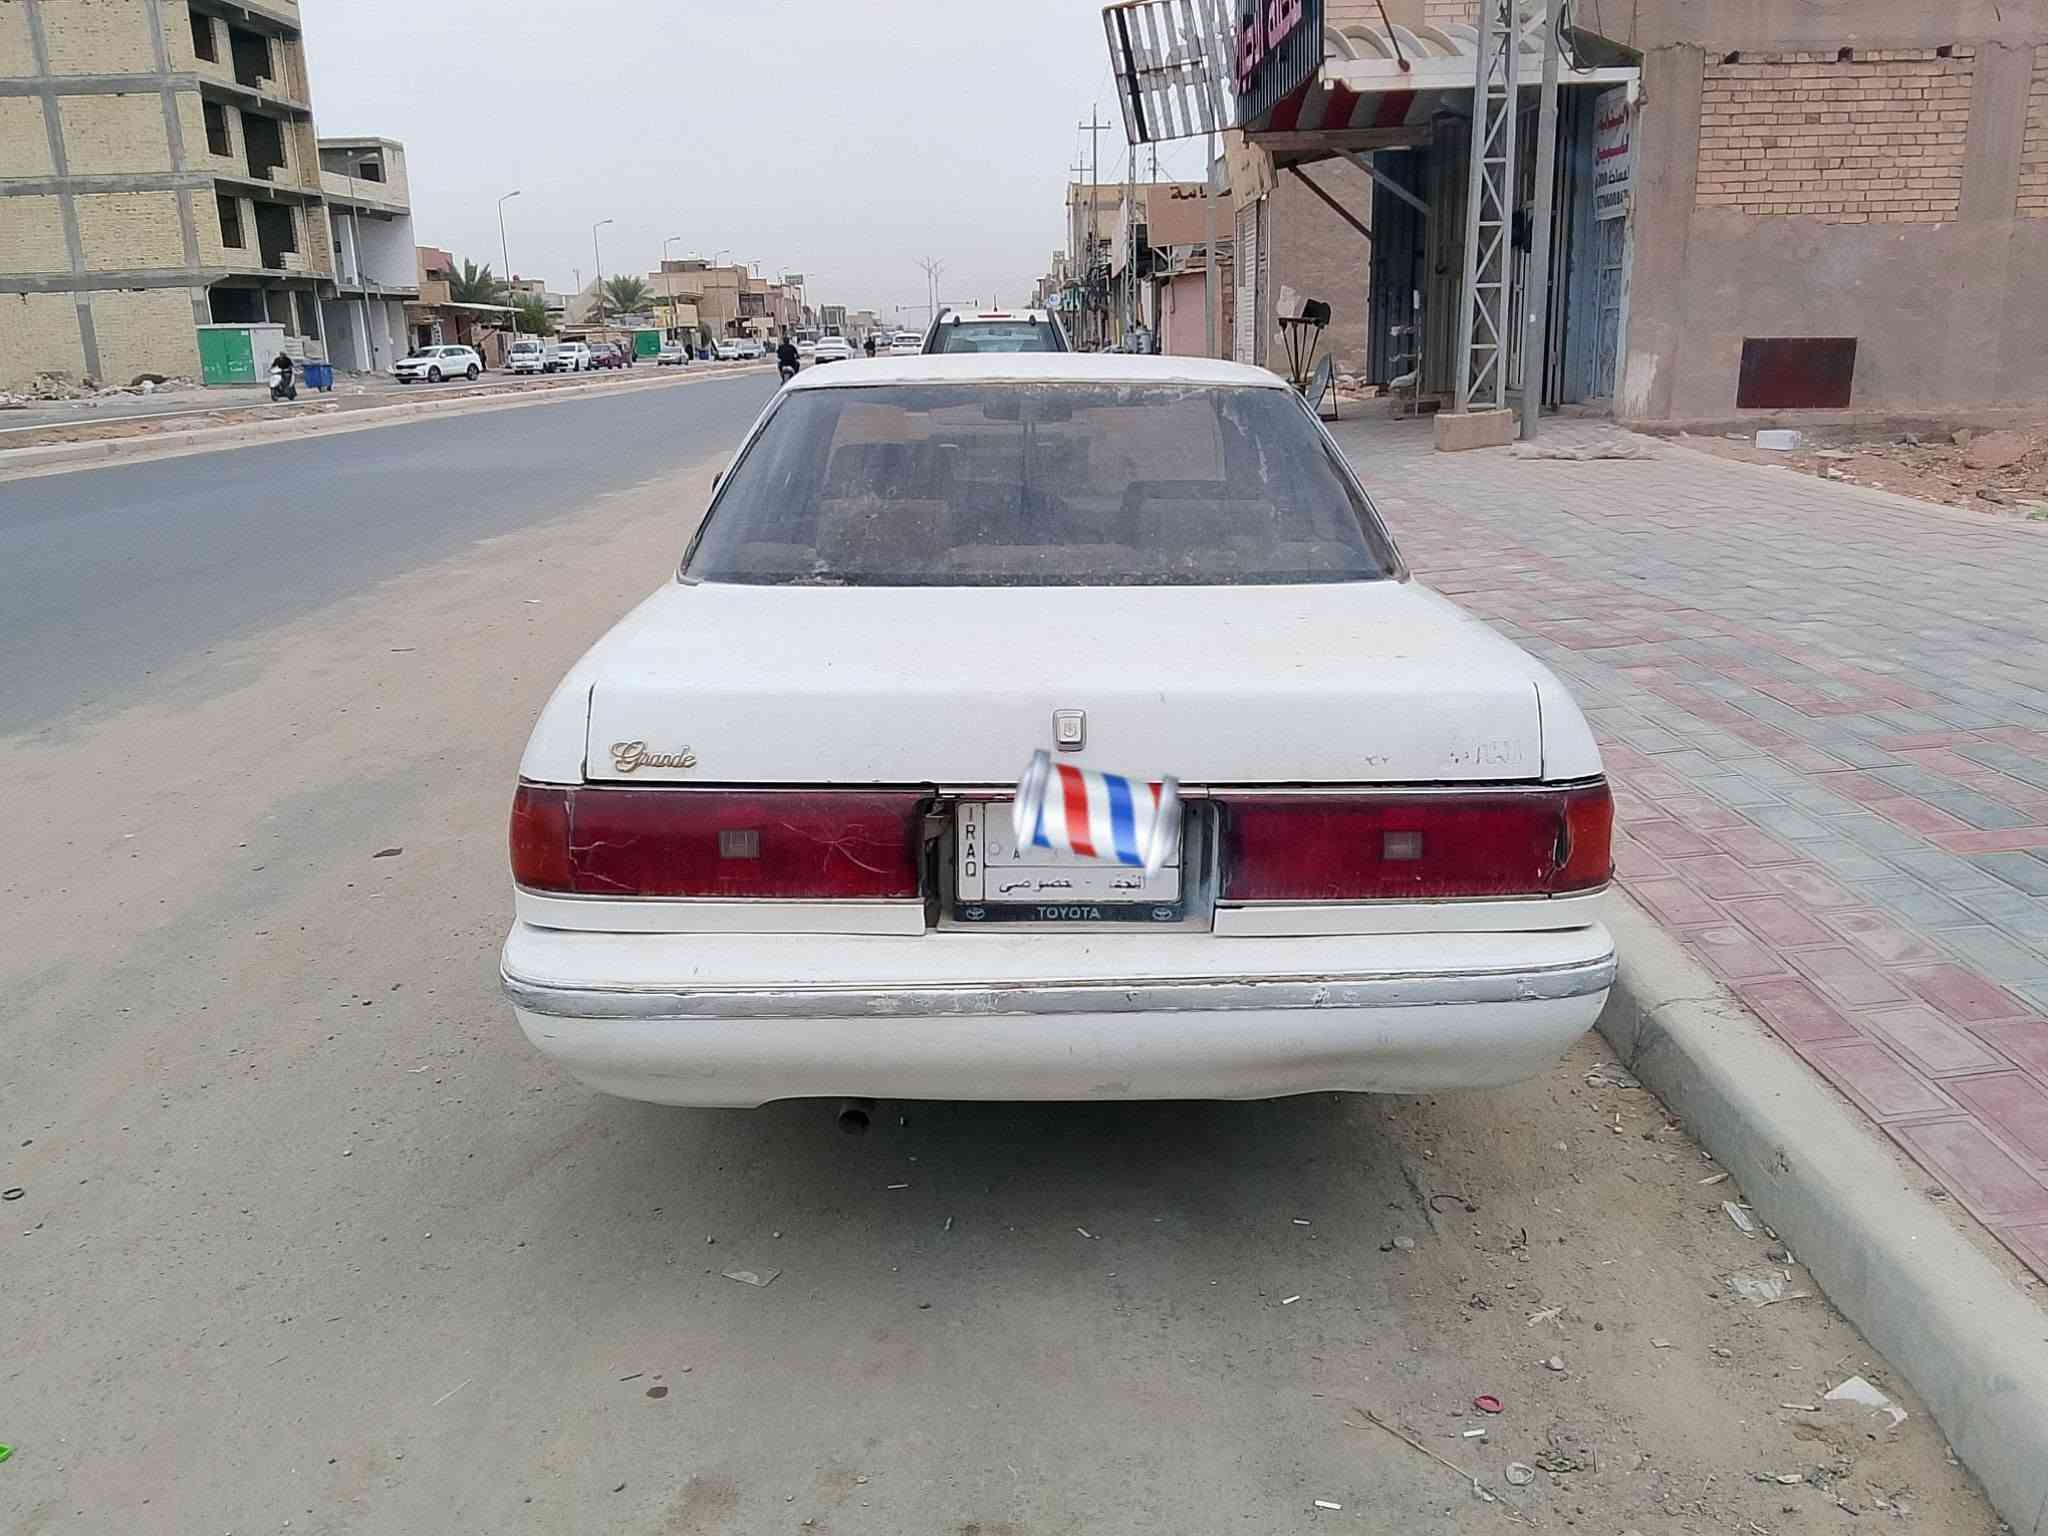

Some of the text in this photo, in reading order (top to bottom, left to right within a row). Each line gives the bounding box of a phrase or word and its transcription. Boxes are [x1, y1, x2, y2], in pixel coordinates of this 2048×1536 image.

[610, 739, 696, 772] Grande
[965, 806, 977, 877] IRAQ
[1036, 906, 1101, 919] TOYOTA
